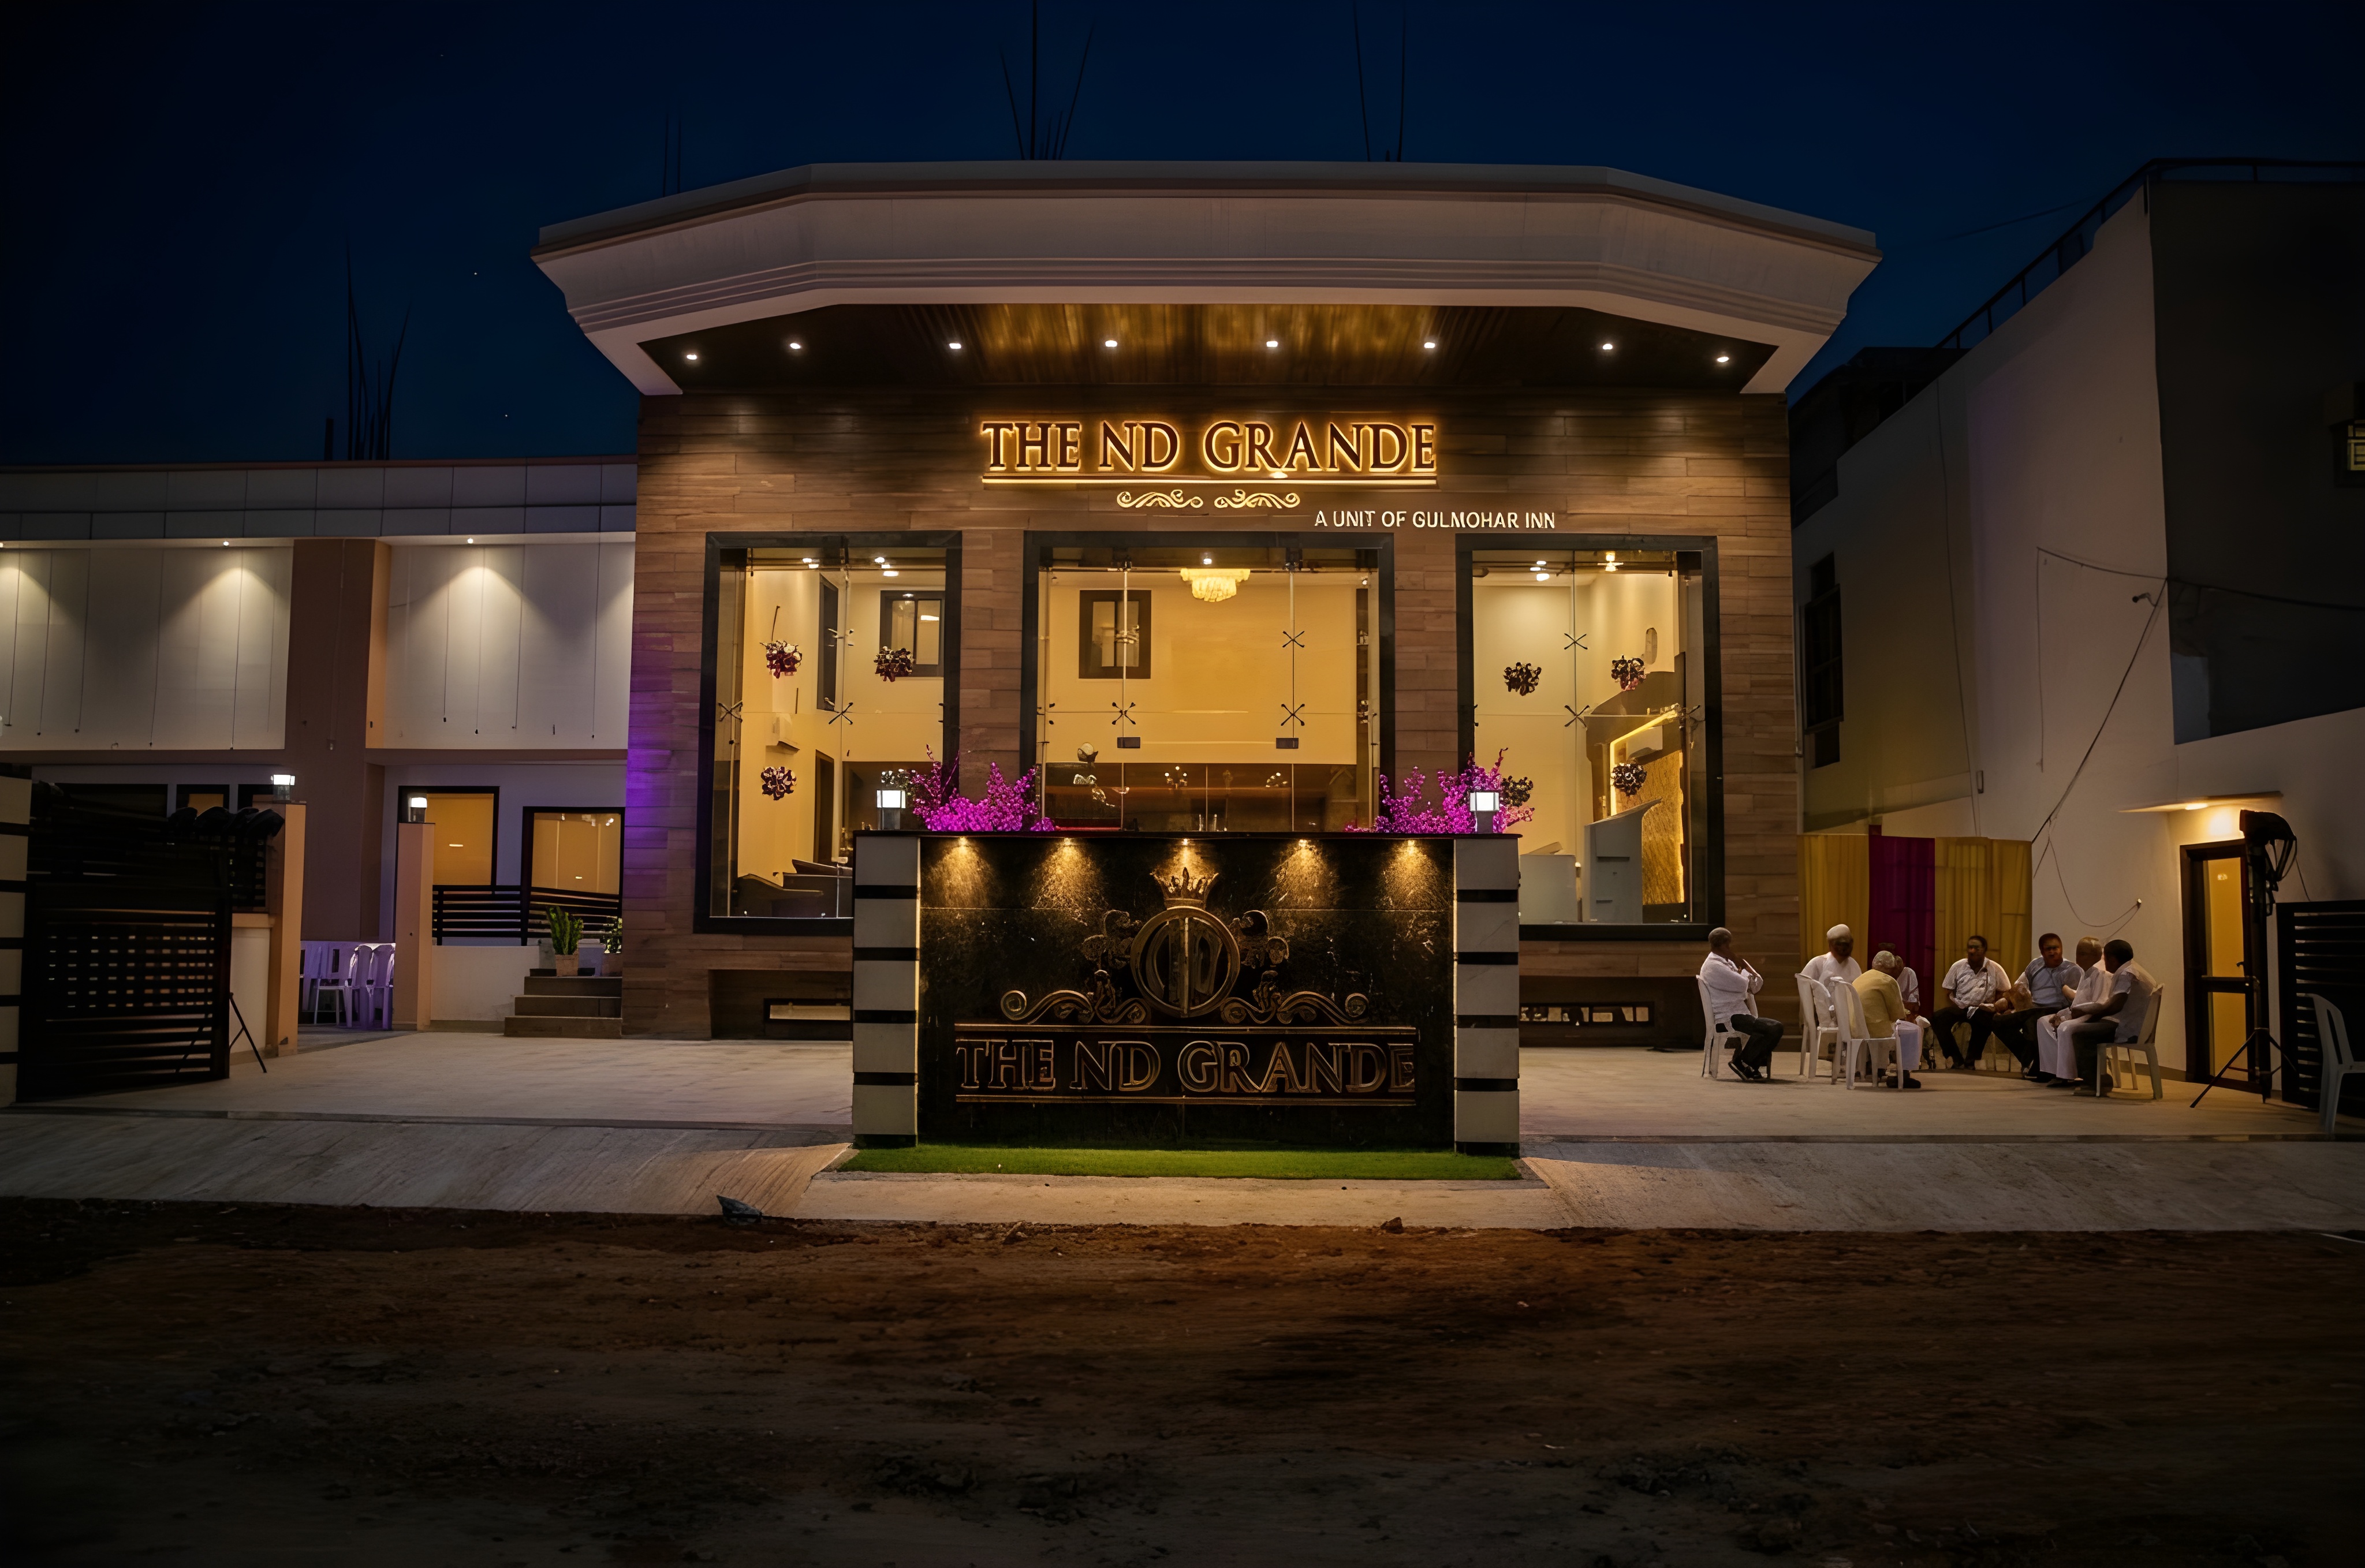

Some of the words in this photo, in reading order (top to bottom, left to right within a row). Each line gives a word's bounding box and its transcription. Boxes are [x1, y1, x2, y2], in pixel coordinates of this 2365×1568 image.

[981, 421, 1081, 472] THE
[1099, 421, 1180, 472] ND
[1202, 421, 1437, 473] GRANDE
[1315, 510, 1327, 527] A
[1333, 510, 1375, 527] UNIT
[1381, 510, 1407, 528] OF
[1412, 511, 1519, 528] GULMOHAR
[1525, 512, 1555, 529] INN
[956, 1040, 1056, 1091] THE
[1069, 1040, 1161, 1092] ND
[1176, 1040, 1416, 1093] GRANDE
